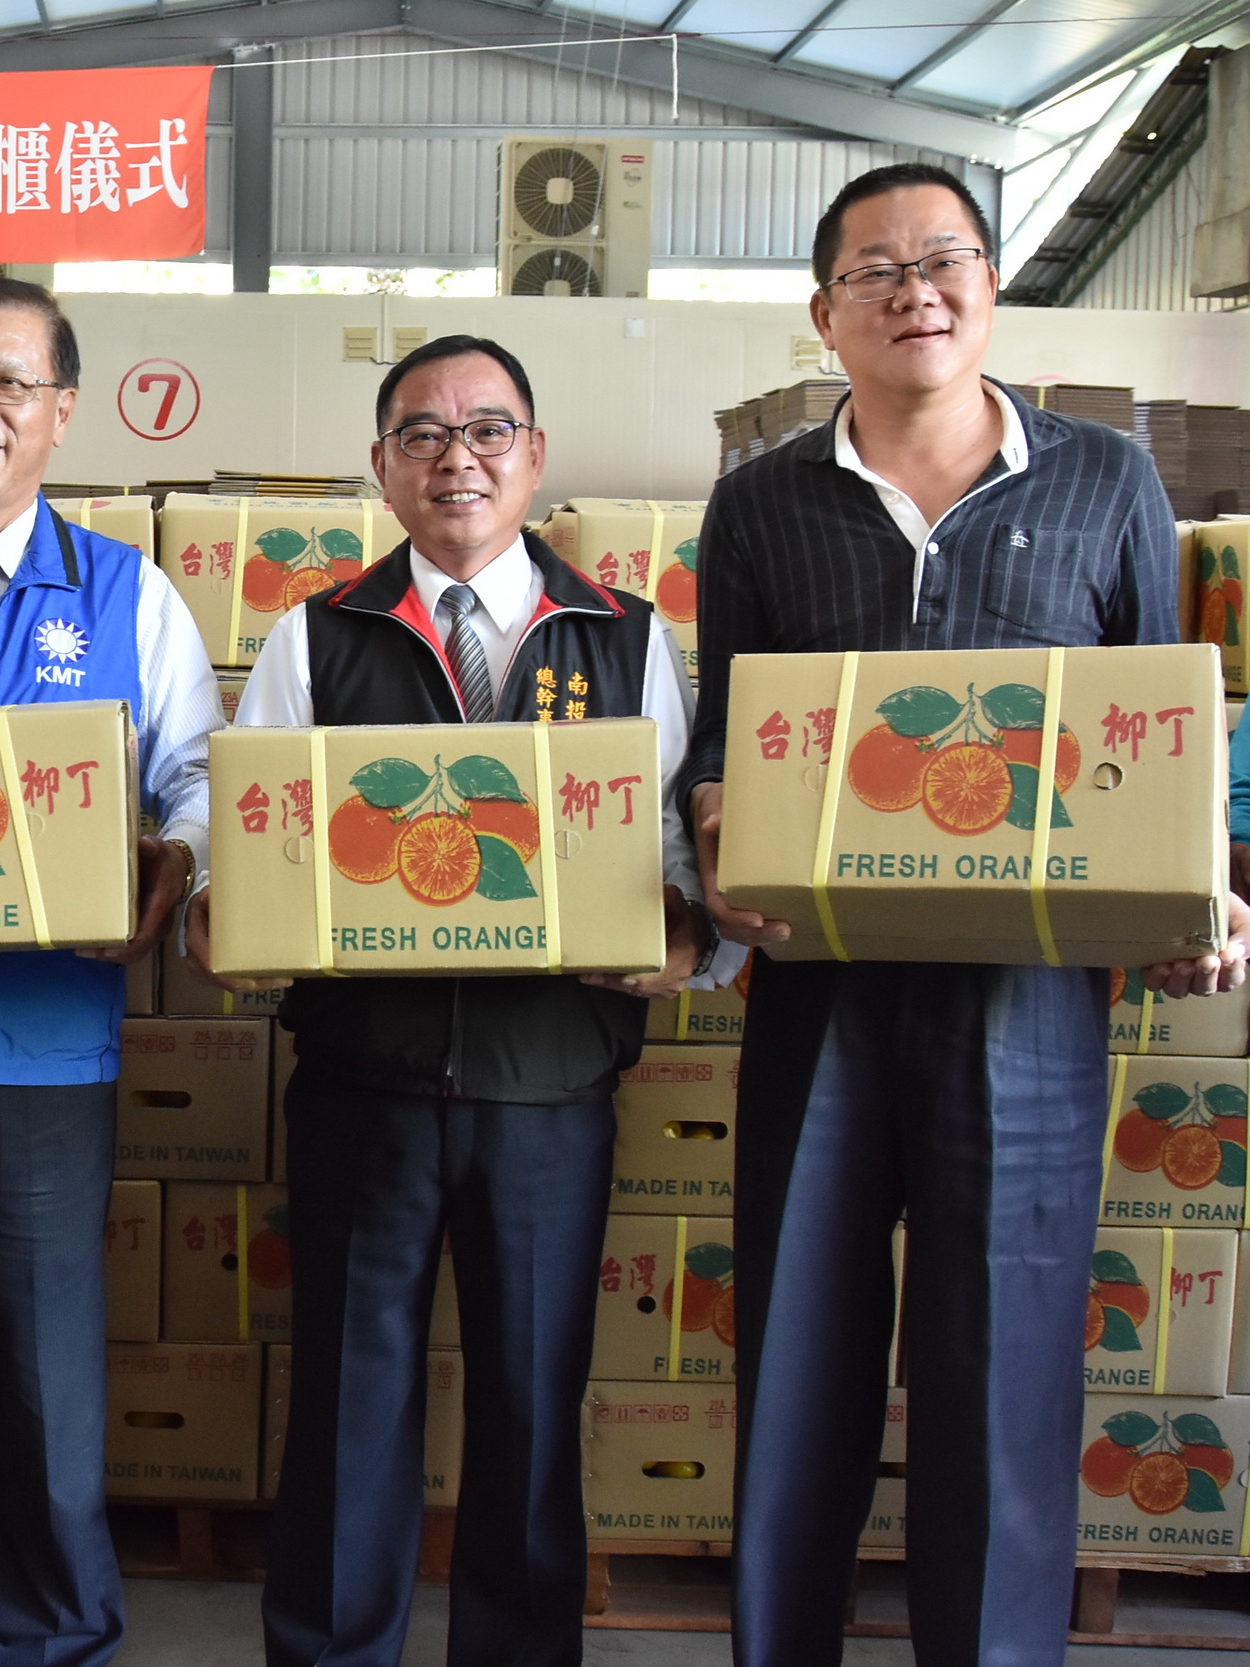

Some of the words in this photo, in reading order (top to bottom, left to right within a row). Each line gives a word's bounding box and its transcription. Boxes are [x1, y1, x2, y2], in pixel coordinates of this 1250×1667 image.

[137, 373, 181, 431] 7
[180, 541, 234, 581] 台灣
[595, 550, 651, 590] 台灣
[36, 665, 86, 687] KMT
[756, 707, 836, 765] 台灣
[1101, 703, 1195, 762] 柳丁
[20, 760, 100, 815] 柳丁
[236, 778, 312, 836] 台灣
[559, 772, 643, 831] 柳丁
[836, 853, 938, 879] FRESH
[432, 925, 547, 951] ORANGE
[688, 1014, 742, 1033] RESH
[151, 1147, 168, 1161] IN
[174, 1146, 249, 1163] TAIWAN
[618, 1178, 677, 1196] MADE
[683, 1180, 702, 1196] IN
[1104, 1201, 1171, 1219] FRESH
[1182, 1203, 1246, 1221] ORAN
[183, 1214, 238, 1251] 台灣
[600, 1254, 656, 1297] 台灣
[250, 1314, 289, 1330] RES
[654, 1357, 721, 1375] FESH
[144, 1464, 162, 1478] IN
[169, 1465, 242, 1482] TAIWAN
[597, 1513, 655, 1529] MADE
[661, 1514, 680, 1529] IN
[1149, 1526, 1234, 1546] ORANGE
